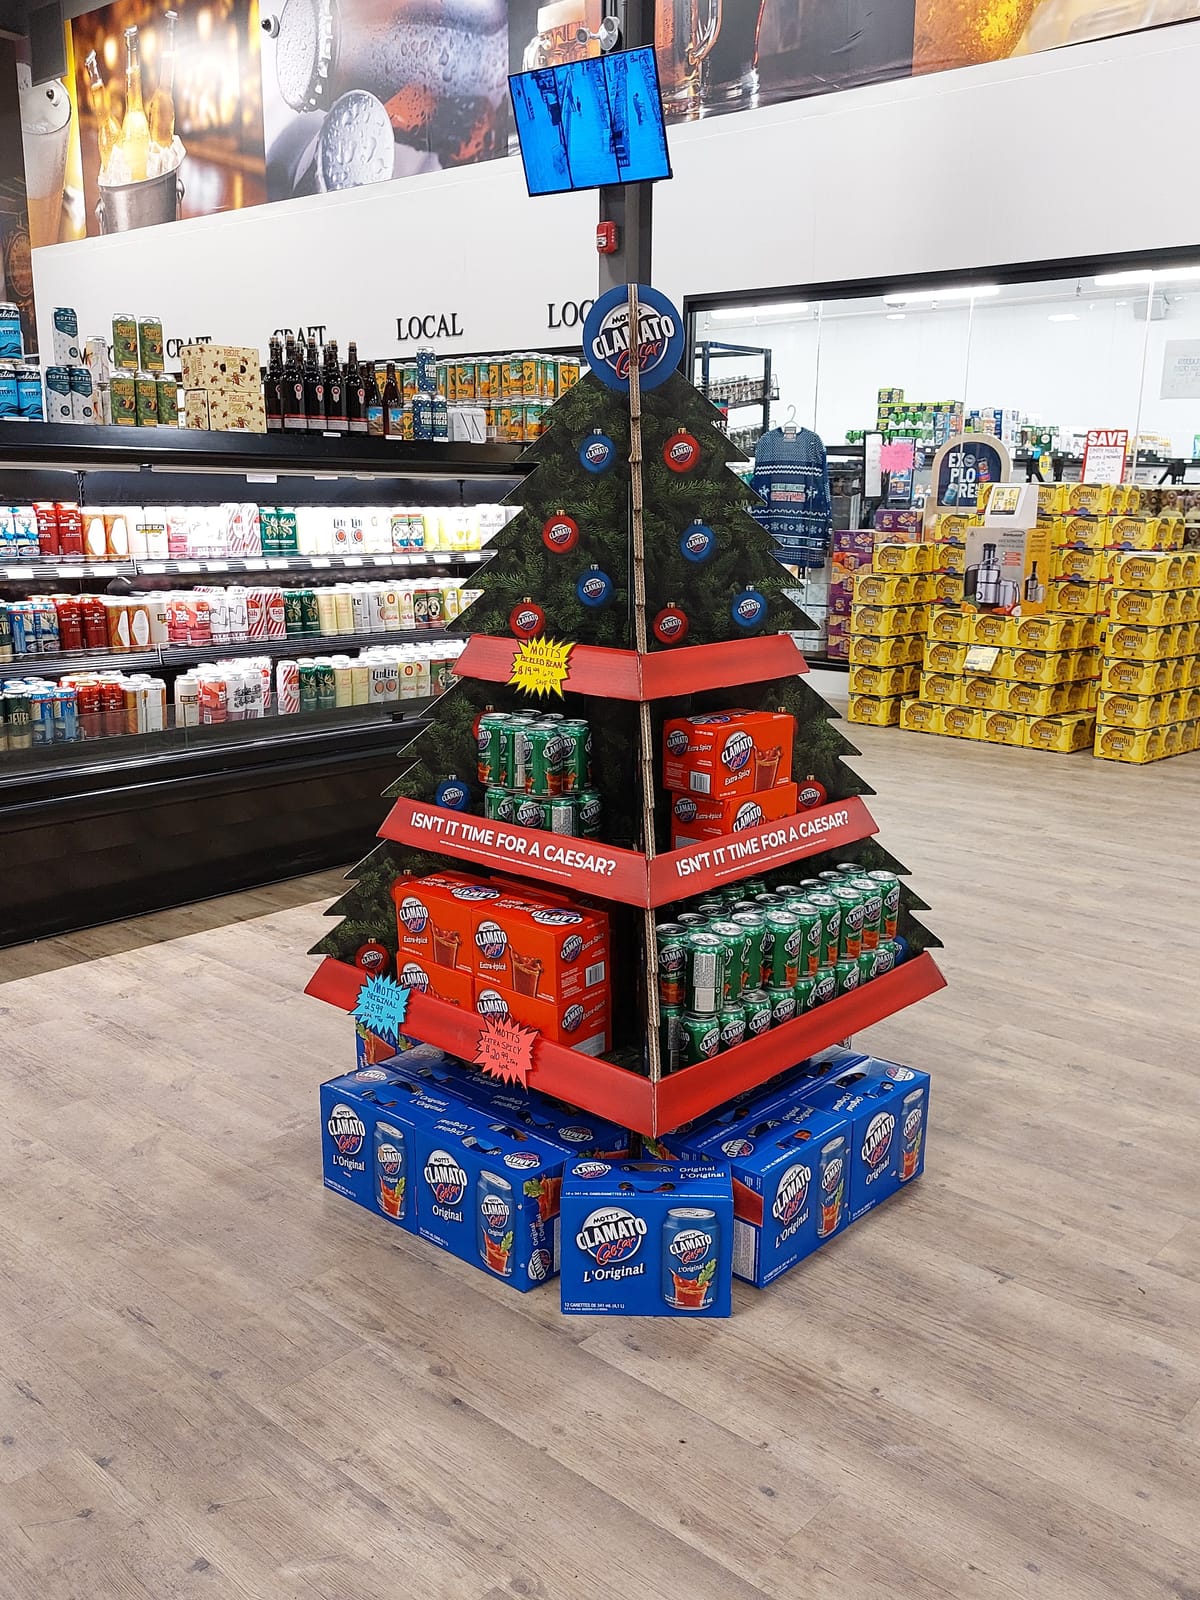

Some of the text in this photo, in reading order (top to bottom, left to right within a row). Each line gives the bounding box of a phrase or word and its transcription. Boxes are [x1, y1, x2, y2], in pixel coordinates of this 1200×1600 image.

[396, 313, 463, 340] LOCAL
[1087, 431, 1126, 446] SAVE
[530, 646, 561, 659] MOTTS
[667, 734, 689, 748] CLAMATO
[721, 735, 753, 764] CLAMATO
[724, 768, 751, 787] Extra Spicy
[674, 801, 697, 815] CLAMATO
[733, 806, 762, 832] CLAMATO
[411, 811, 445, 833] ISN'T
[445, 820, 460, 836] IT
[461, 824, 494, 846] TIME
[496, 832, 527, 855] FOR
[528, 842, 541, 858] A
[543, 845, 617, 876] CAESAR?
[676, 852, 711, 877] ISN'T
[712, 848, 725, 866] IT
[726, 838, 760, 862] TIME
[761, 829, 789, 851] FOR
[789, 825, 799, 841] A
[799, 810, 849, 838] CAESAR?
[399, 906, 429, 921] CLAMATO
[475, 931, 507, 946] CLAMATO
[561, 936, 583, 960] CLAMATO
[400, 972, 429, 986] CLAMATO
[367, 991, 397, 1009] ORIGINAL
[374, 982, 400, 1001] MOTTS
[476, 999, 509, 1014] CLAMATO
[561, 1005, 584, 1029] CLAMATO
[501, 1042, 522, 1055] SPICY
[328, 1118, 366, 1137] CLAMATO
[903, 1109, 922, 1134] CLAMATO
[861, 1115, 895, 1161] CLAMATO
[332, 1154, 365, 1171] L'Original
[503, 1154, 540, 1169] CLAMATO
[571, 1164, 612, 1175] CLAMATO
[679, 1165, 715, 1173] Original
[865, 1156, 890, 1185] Original
[424, 1166, 468, 1187] CLAMATO
[821, 1159, 843, 1188] CLAMATO
[435, 1183, 460, 1203] Caesar
[772, 1166, 812, 1218] CLAMATO
[432, 1205, 462, 1222] Original
[481, 1203, 510, 1216] CLAMATO
[593, 1212, 620, 1224] MOTT'S
[487, 1228, 504, 1237] Original
[576, 1218, 648, 1250] CLAMATO
[775, 1208, 809, 1248] L'Original
[596, 1237, 636, 1265] Caesar
[669, 1235, 712, 1255] CLAMATO
[681, 1247, 705, 1264] Caesar
[583, 1263, 644, 1282] L'Original
[677, 1263, 704, 1273] L'Original
